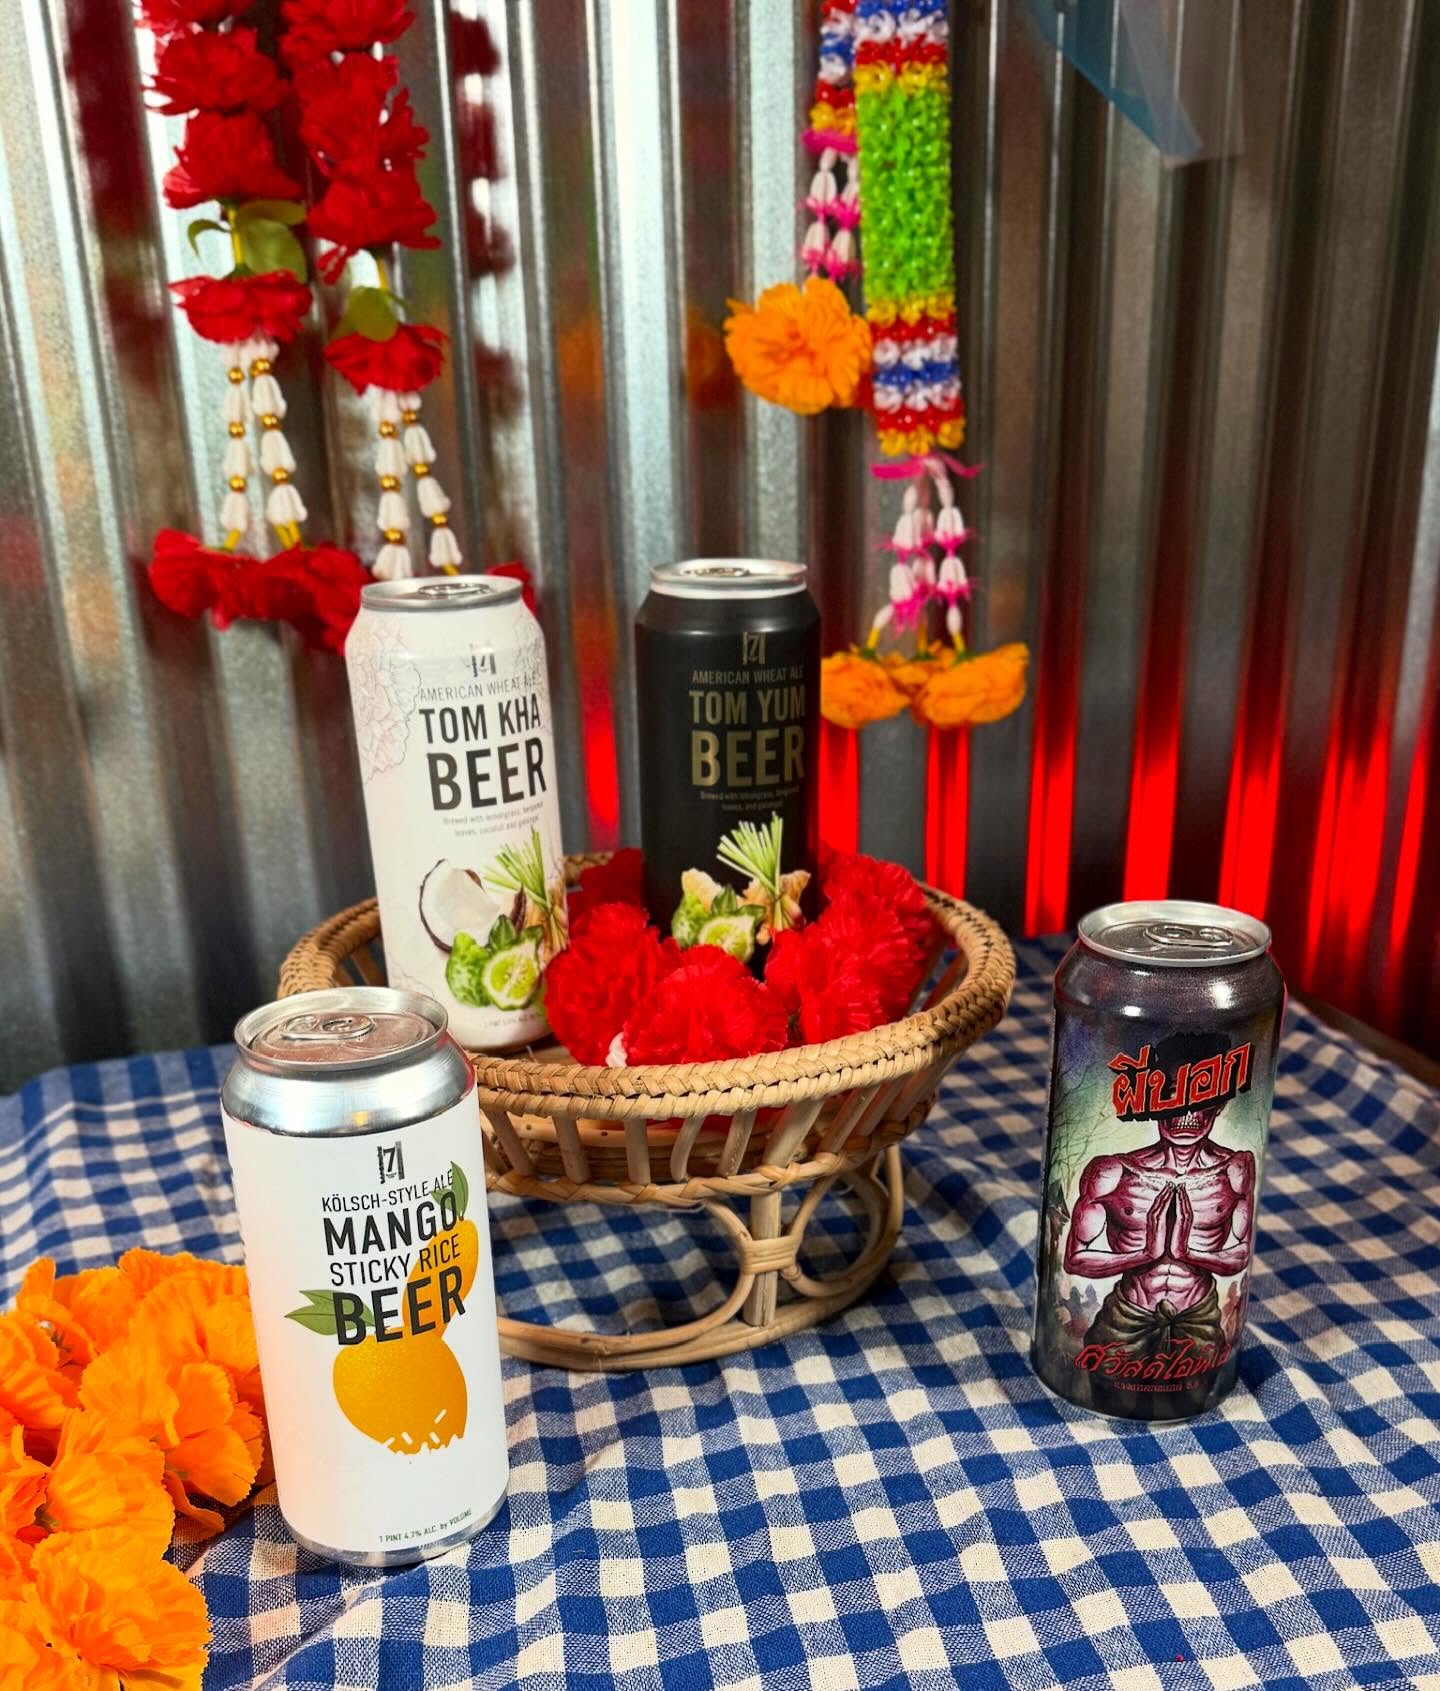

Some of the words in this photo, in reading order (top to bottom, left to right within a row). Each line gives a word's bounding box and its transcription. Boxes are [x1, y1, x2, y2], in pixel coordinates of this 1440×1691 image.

[420, 684, 483, 702] AMERICAN
[488, 677, 520, 696] WHEAT
[692, 670, 750, 685] AMERICAN
[753, 668, 787, 684] WHEAT
[790, 664, 804, 680] ALE
[419, 704, 488, 744] TOM
[498, 693, 541, 736] KHA
[688, 689, 748, 725] TOM
[756, 684, 806, 723] YUM
[426, 736, 547, 811] BEER
[691, 725, 805, 787] BEER
[1107, 1041, 1252, 1117] ผีบอก
[321, 1180, 430, 1213] KÖLSCH-STYLE
[434, 1168, 454, 1193] ALE
[323, 1191, 458, 1256] MANGO
[330, 1253, 411, 1287] STICKY
[419, 1233, 461, 1273] RICE
[332, 1265, 466, 1346] BEER
[385, 1533, 401, 1542] PINT
[449, 1508, 472, 1526] VOLUME
